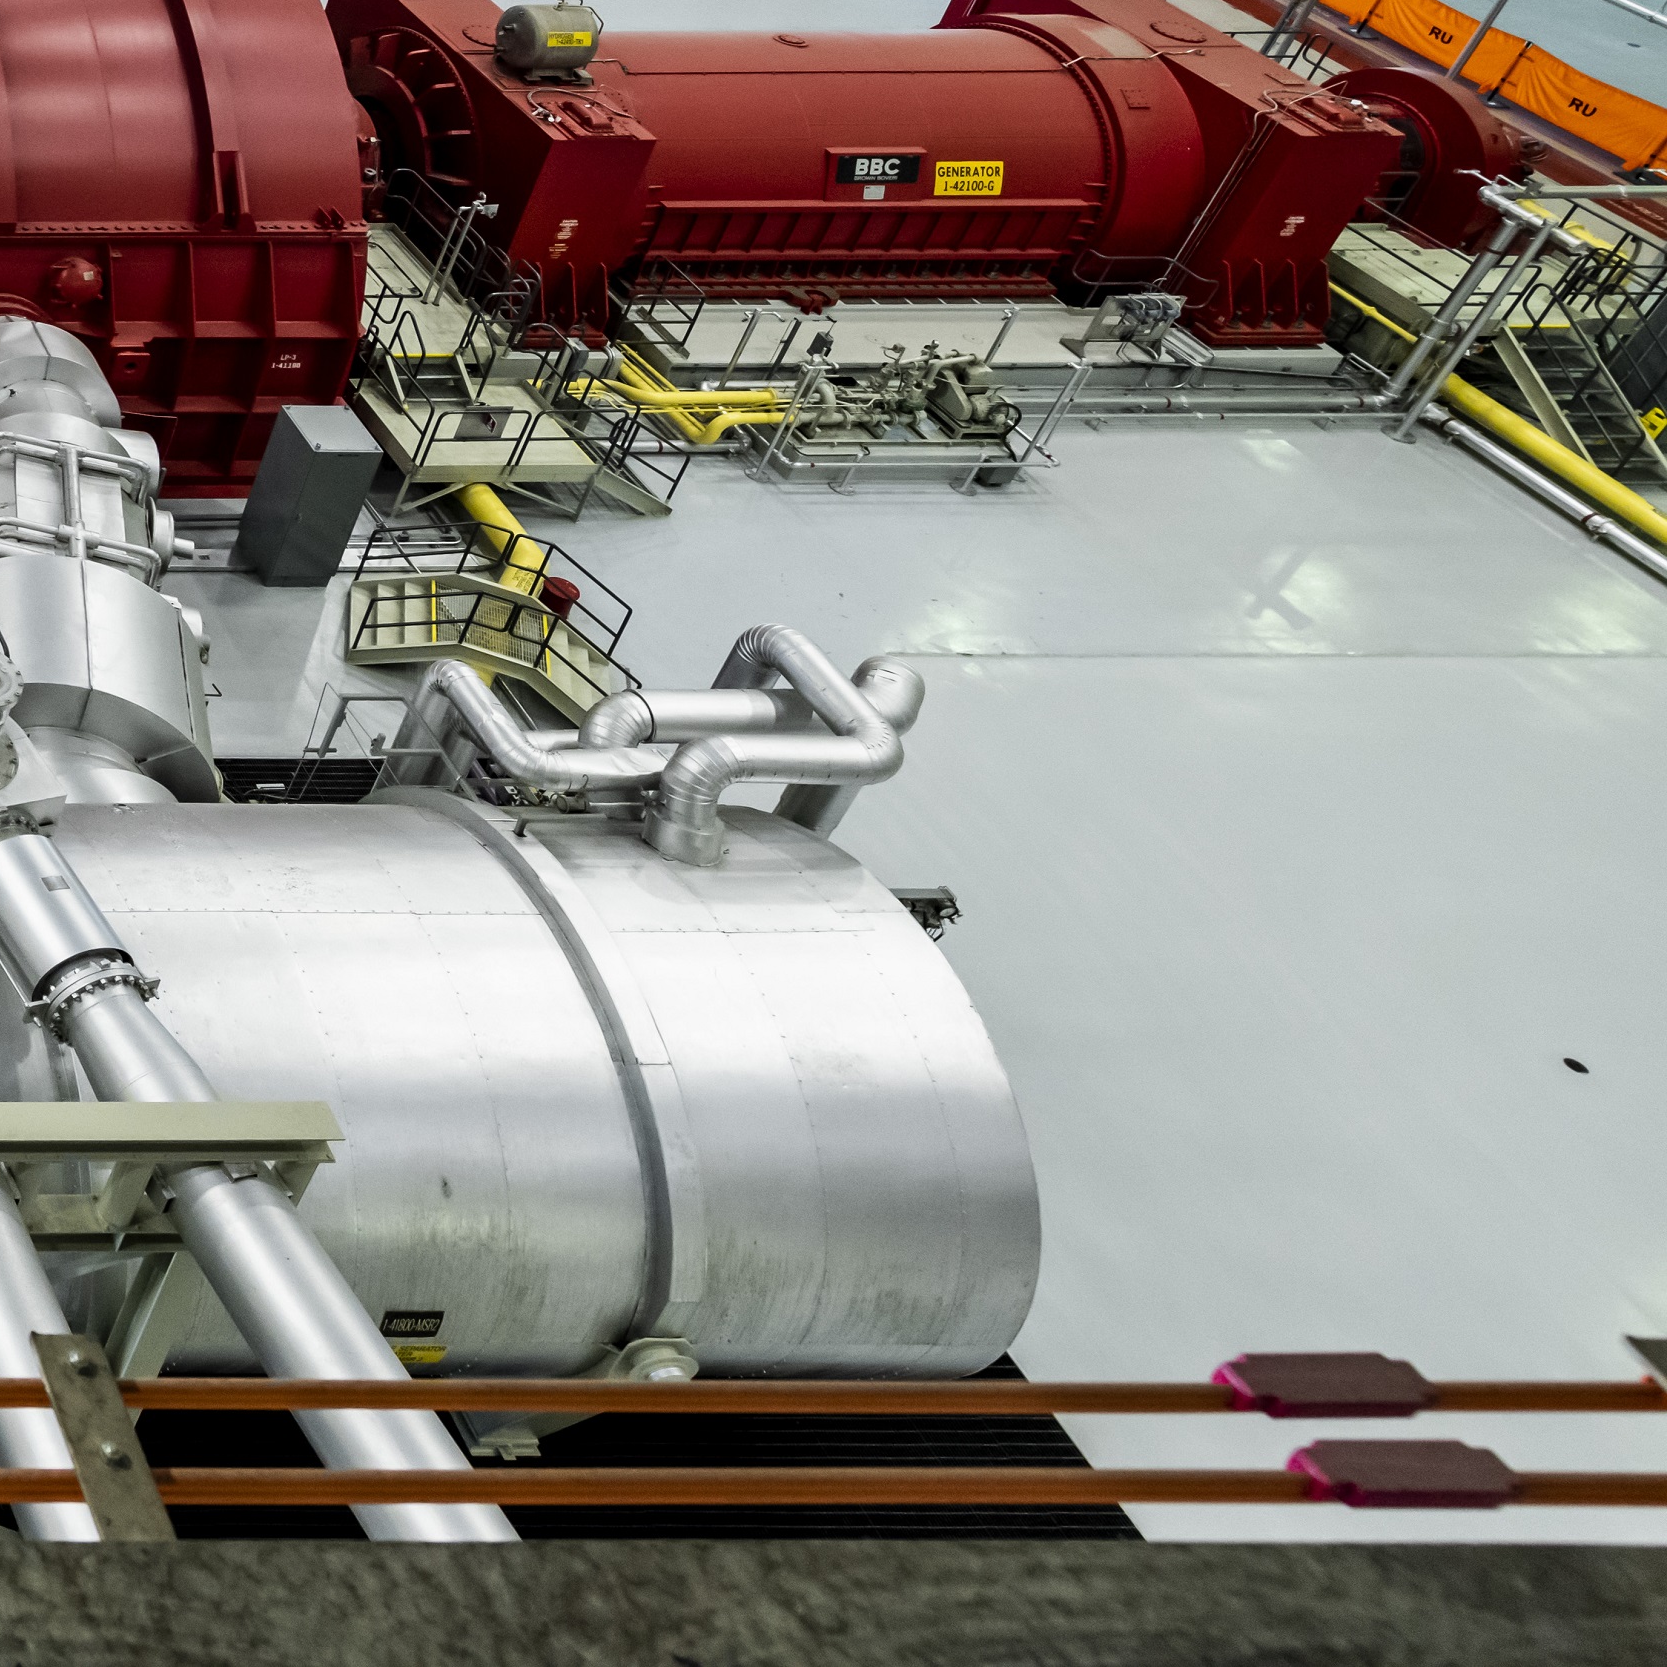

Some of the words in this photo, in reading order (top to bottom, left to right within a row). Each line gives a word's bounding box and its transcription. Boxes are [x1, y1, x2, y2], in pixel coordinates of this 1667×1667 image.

[1428, 25, 1454, 45] RU
[1568, 97, 1598, 118] RU
[854, 159, 901, 176] BBC
[937, 166, 1001, 178] GENERATOR
[943, 180, 995, 192] 1-42100-G
[382, 1318, 441, 1332] 1-41800-MSR2
